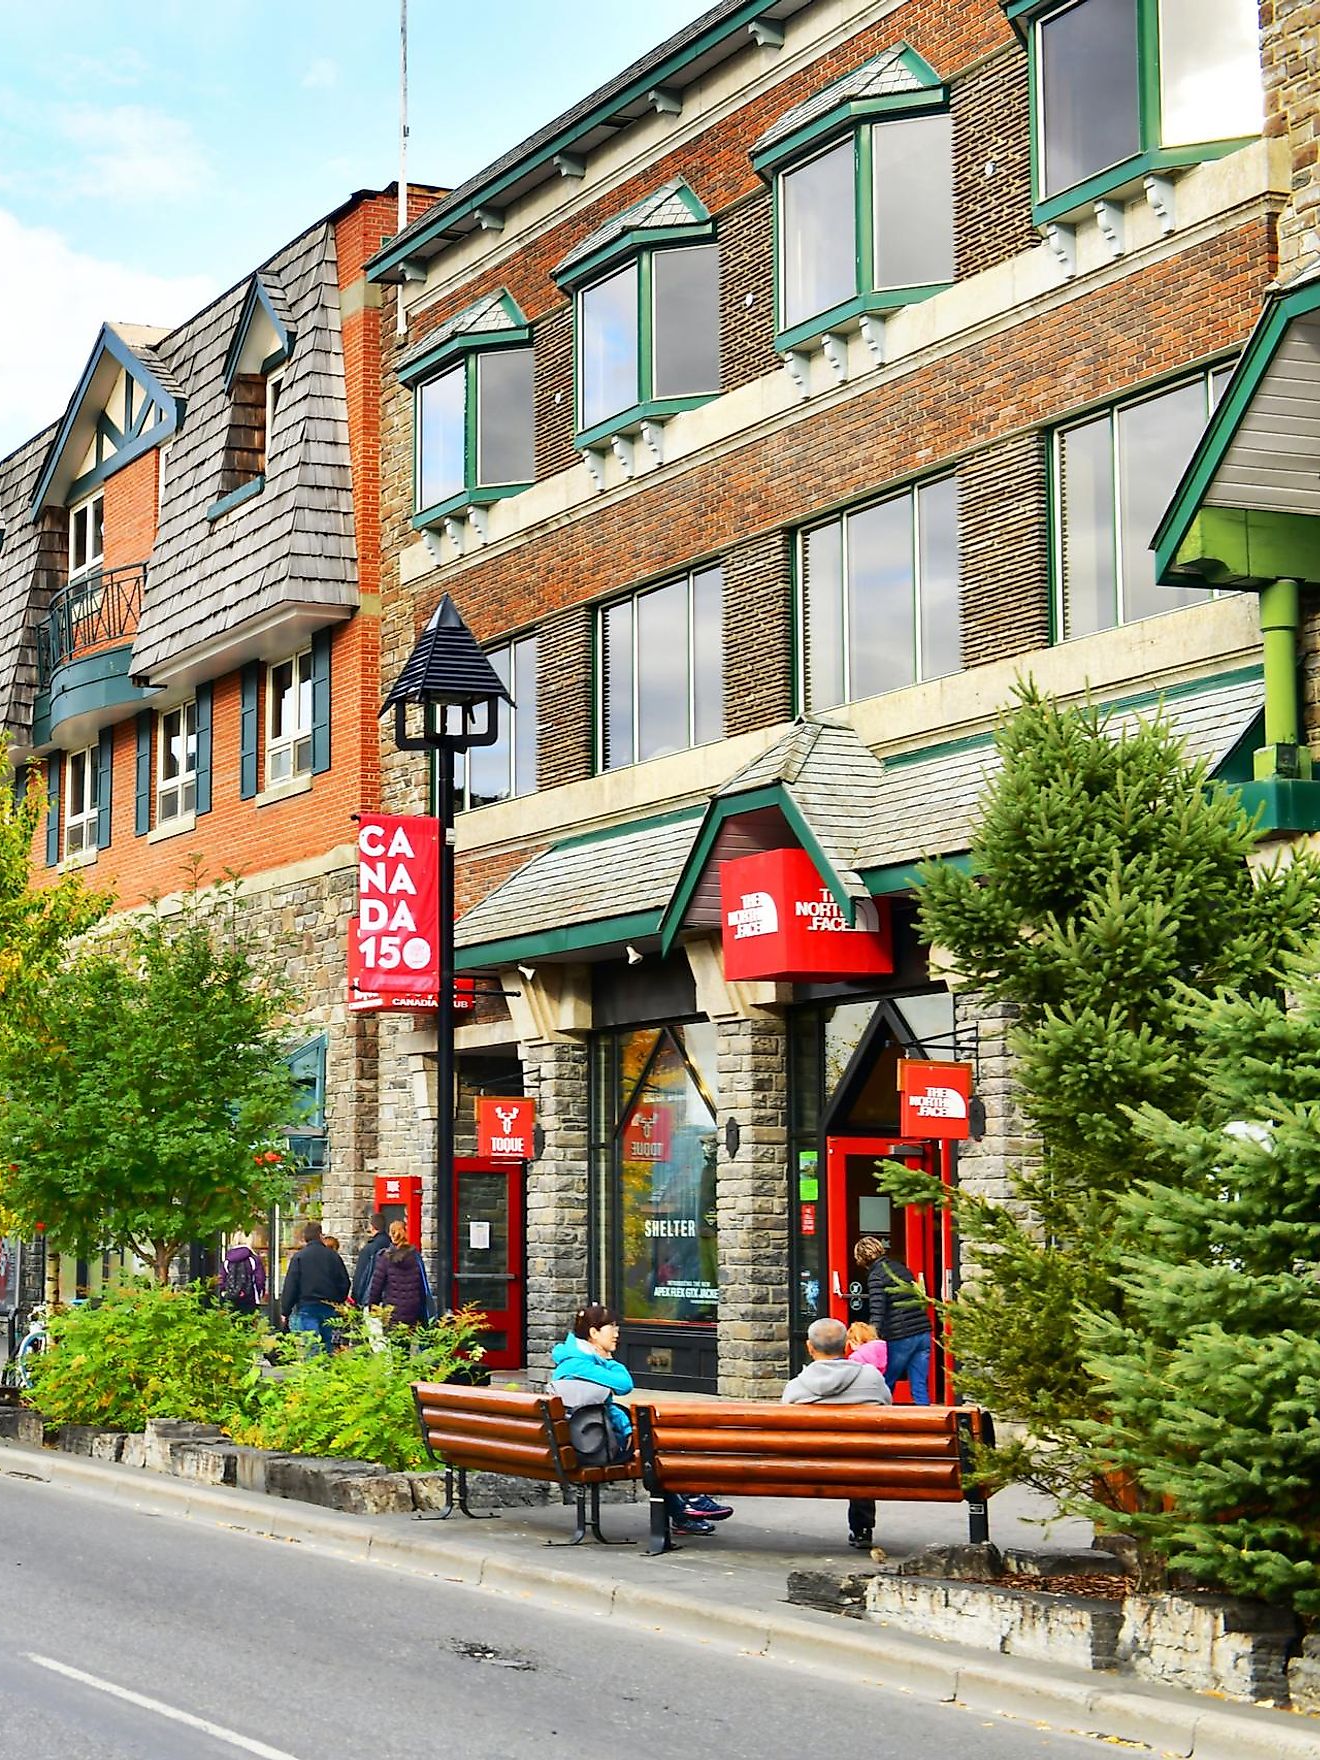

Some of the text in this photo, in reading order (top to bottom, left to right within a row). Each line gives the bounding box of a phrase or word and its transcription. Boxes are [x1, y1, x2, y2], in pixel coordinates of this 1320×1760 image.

[358, 825, 415, 858] CA
[359, 861, 417, 895] NA
[740, 892, 763, 909] THE
[795, 901, 845, 917] NORT
[359, 898, 417, 932] DA
[727, 906, 763, 927] NORTH
[358, 935, 431, 970] 150
[392, 997, 439, 1008] CANADIA
[924, 1087, 949, 1098] THE
[909, 1095, 950, 1108] NORTH
[491, 1137, 525, 1153] TOQUE
[644, 1219, 696, 1238] SHELTER
[654, 1286, 670, 1297] APEX
[670, 1287, 685, 1298] FLEX
[699, 1288, 720, 1299] JACKE
